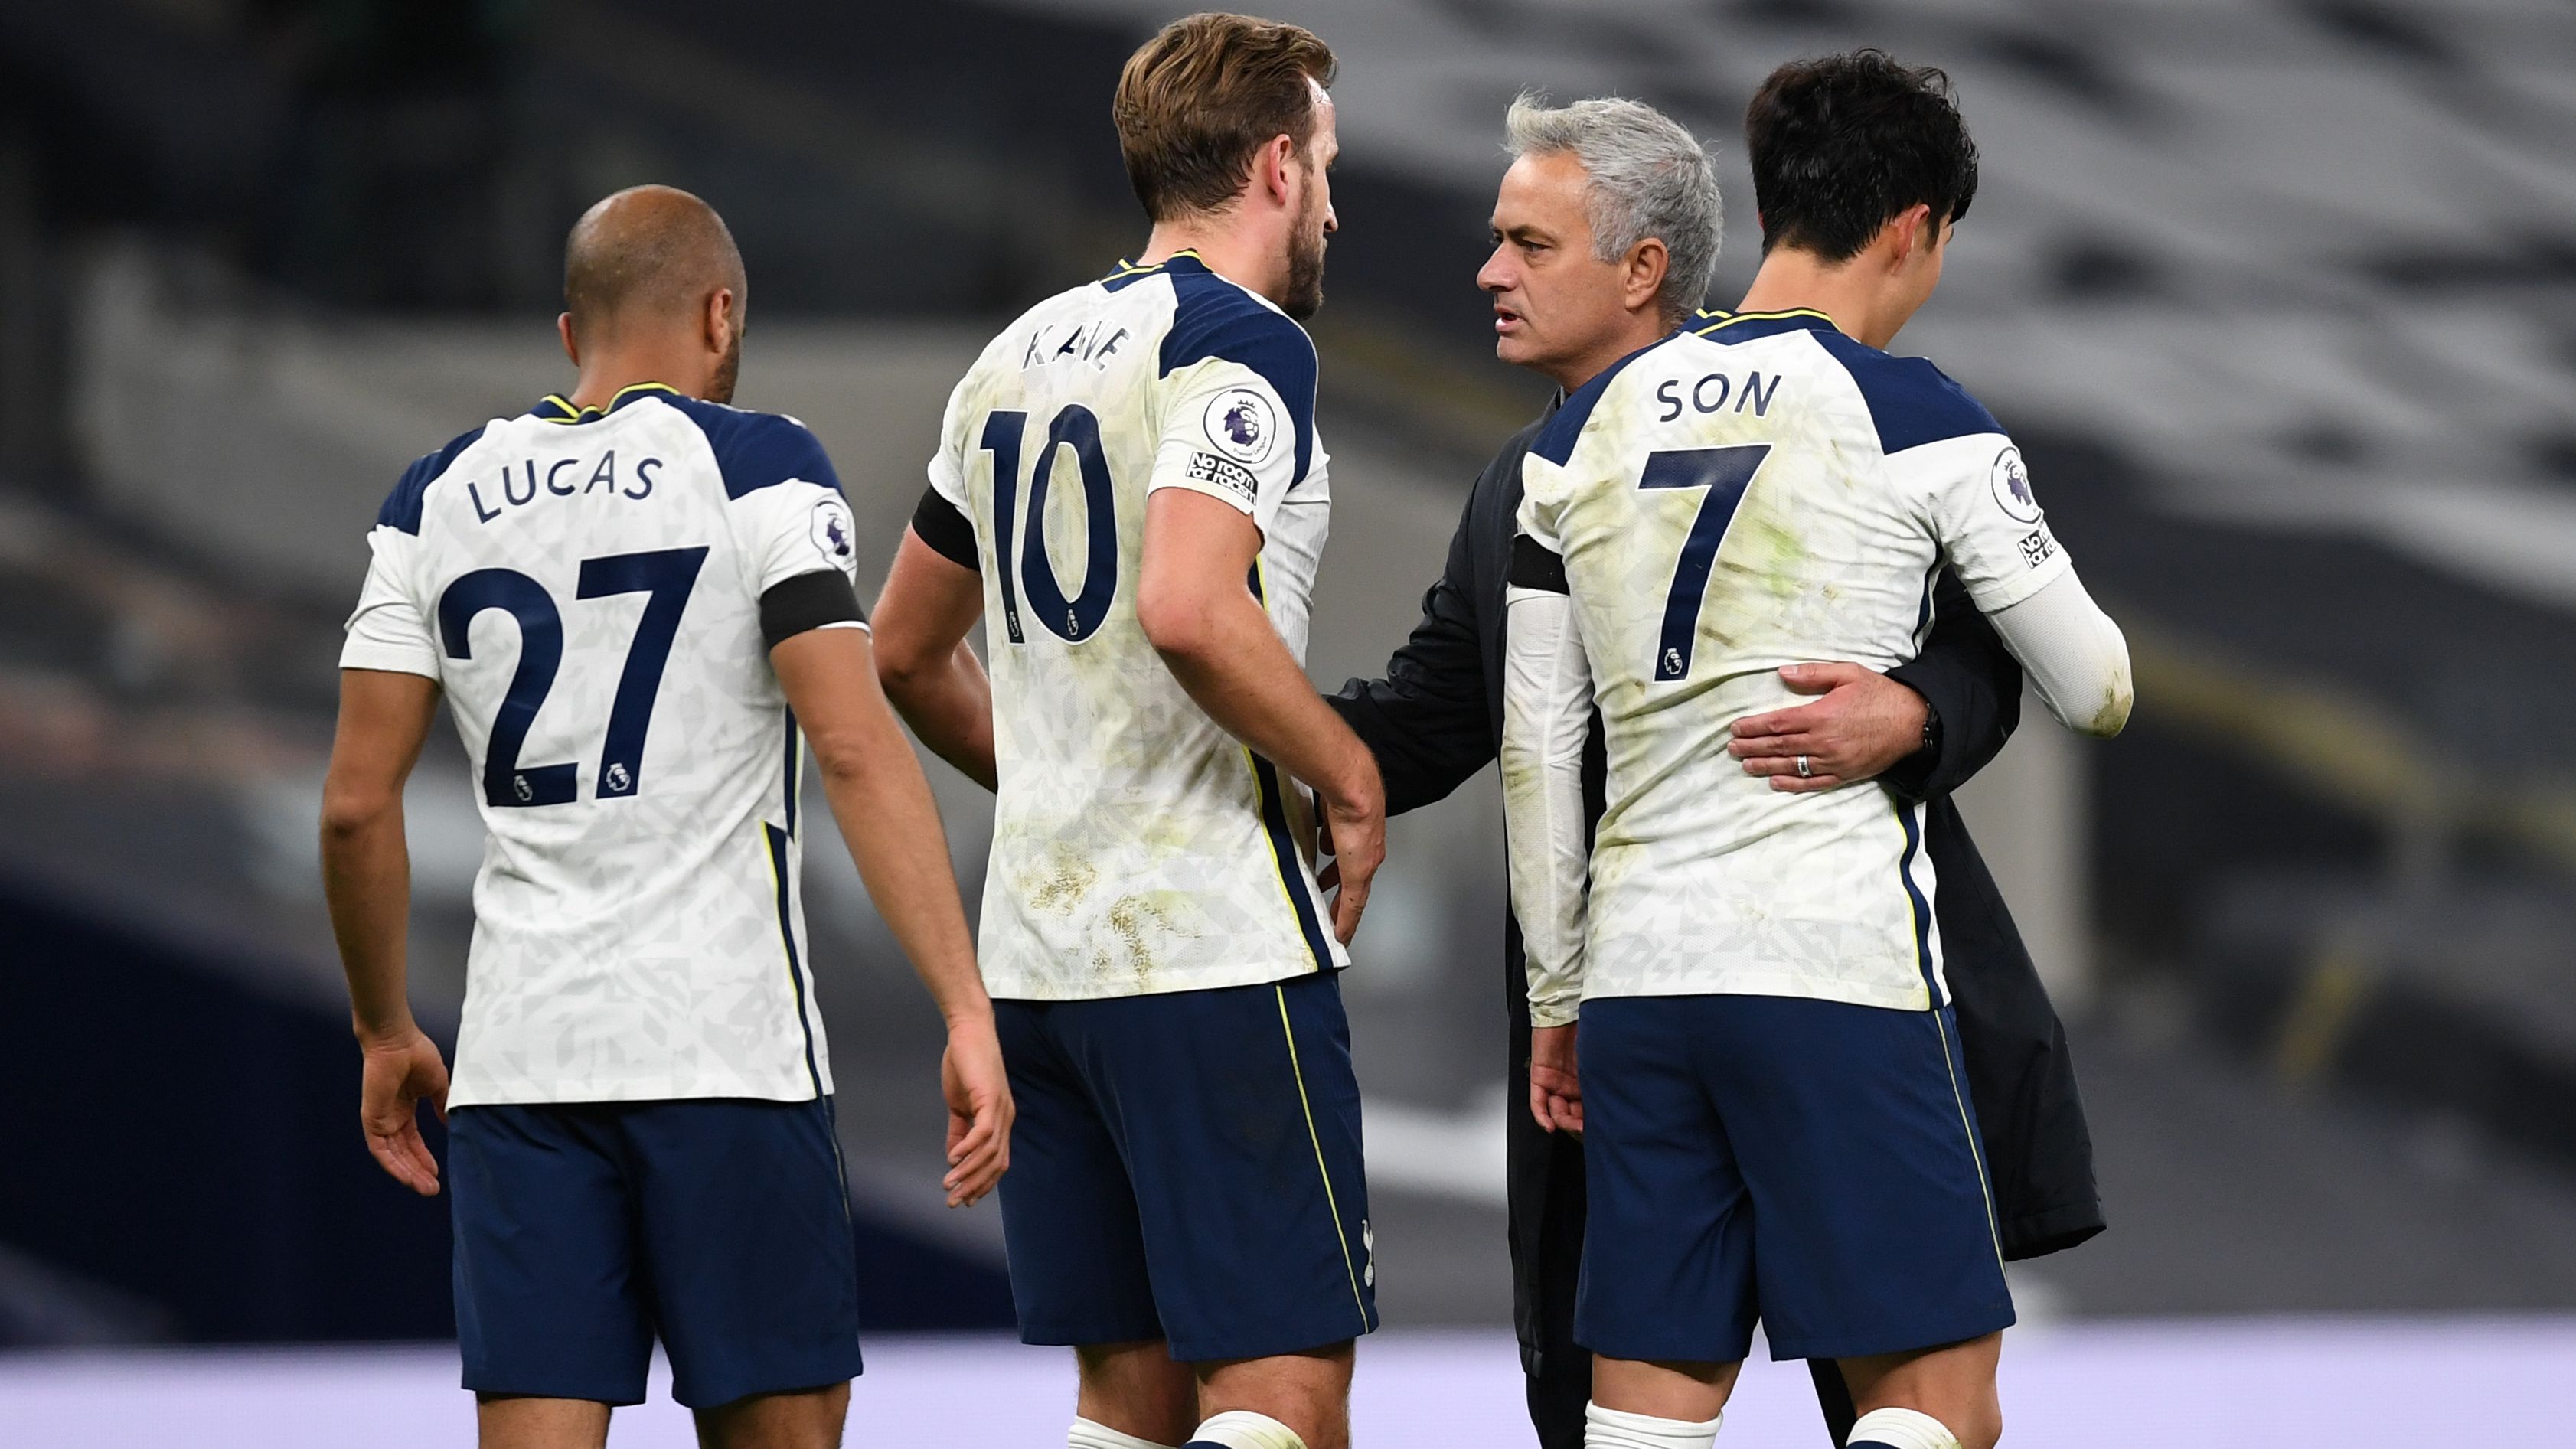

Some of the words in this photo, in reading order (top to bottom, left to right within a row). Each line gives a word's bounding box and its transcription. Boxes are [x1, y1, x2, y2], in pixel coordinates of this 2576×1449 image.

[1656, 370, 1782, 423] SON
[467, 450, 663, 524] LUCAS
[1187, 464, 1213, 480] for
[1213, 472, 1257, 506] racism
[1190, 452, 1216, 469] No
[1217, 460, 1255, 491] room
[980, 403, 1118, 644] 10
[2018, 536, 2041, 556] No
[1638, 443, 1772, 682] 7
[2026, 547, 2045, 569] for
[437, 545, 710, 808] 27
